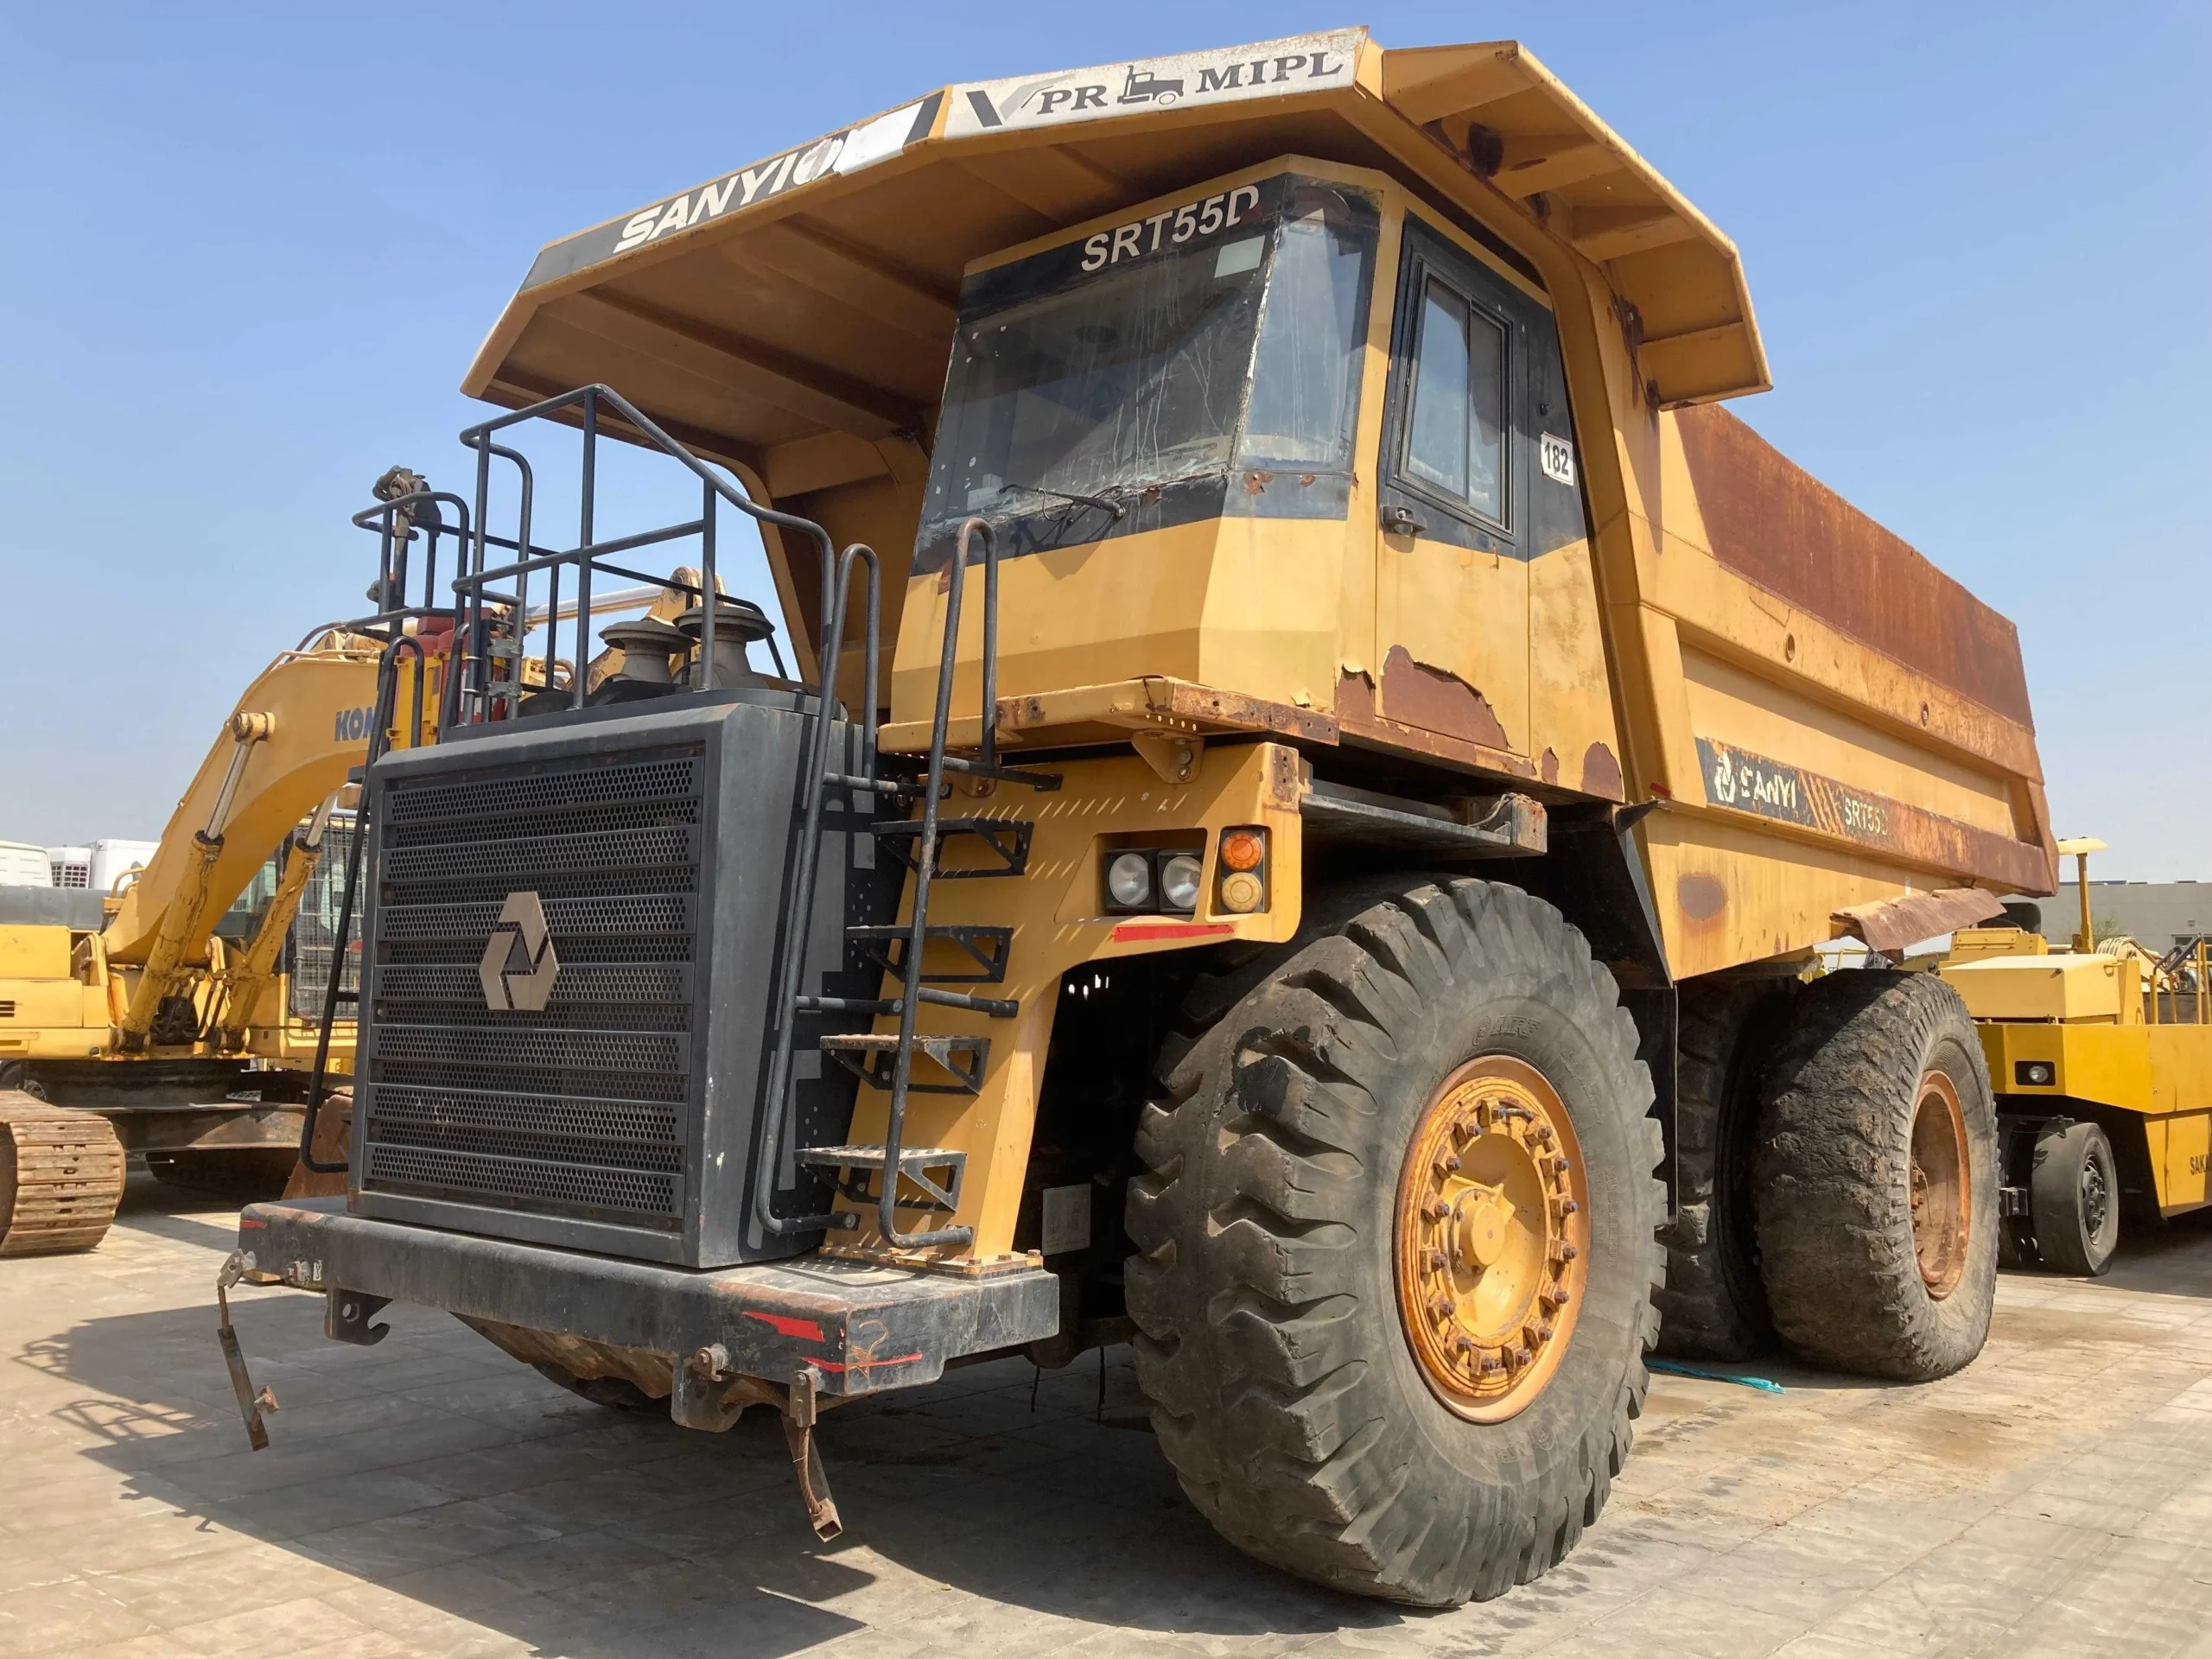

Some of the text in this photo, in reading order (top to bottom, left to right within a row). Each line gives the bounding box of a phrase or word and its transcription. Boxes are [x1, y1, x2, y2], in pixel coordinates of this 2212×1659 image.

[1195, 51, 1344, 93] MIPL
[612, 150, 799, 254] SANYI
[1081, 184, 1260, 272] SRT55D
[1544, 441, 1569, 476] 182
